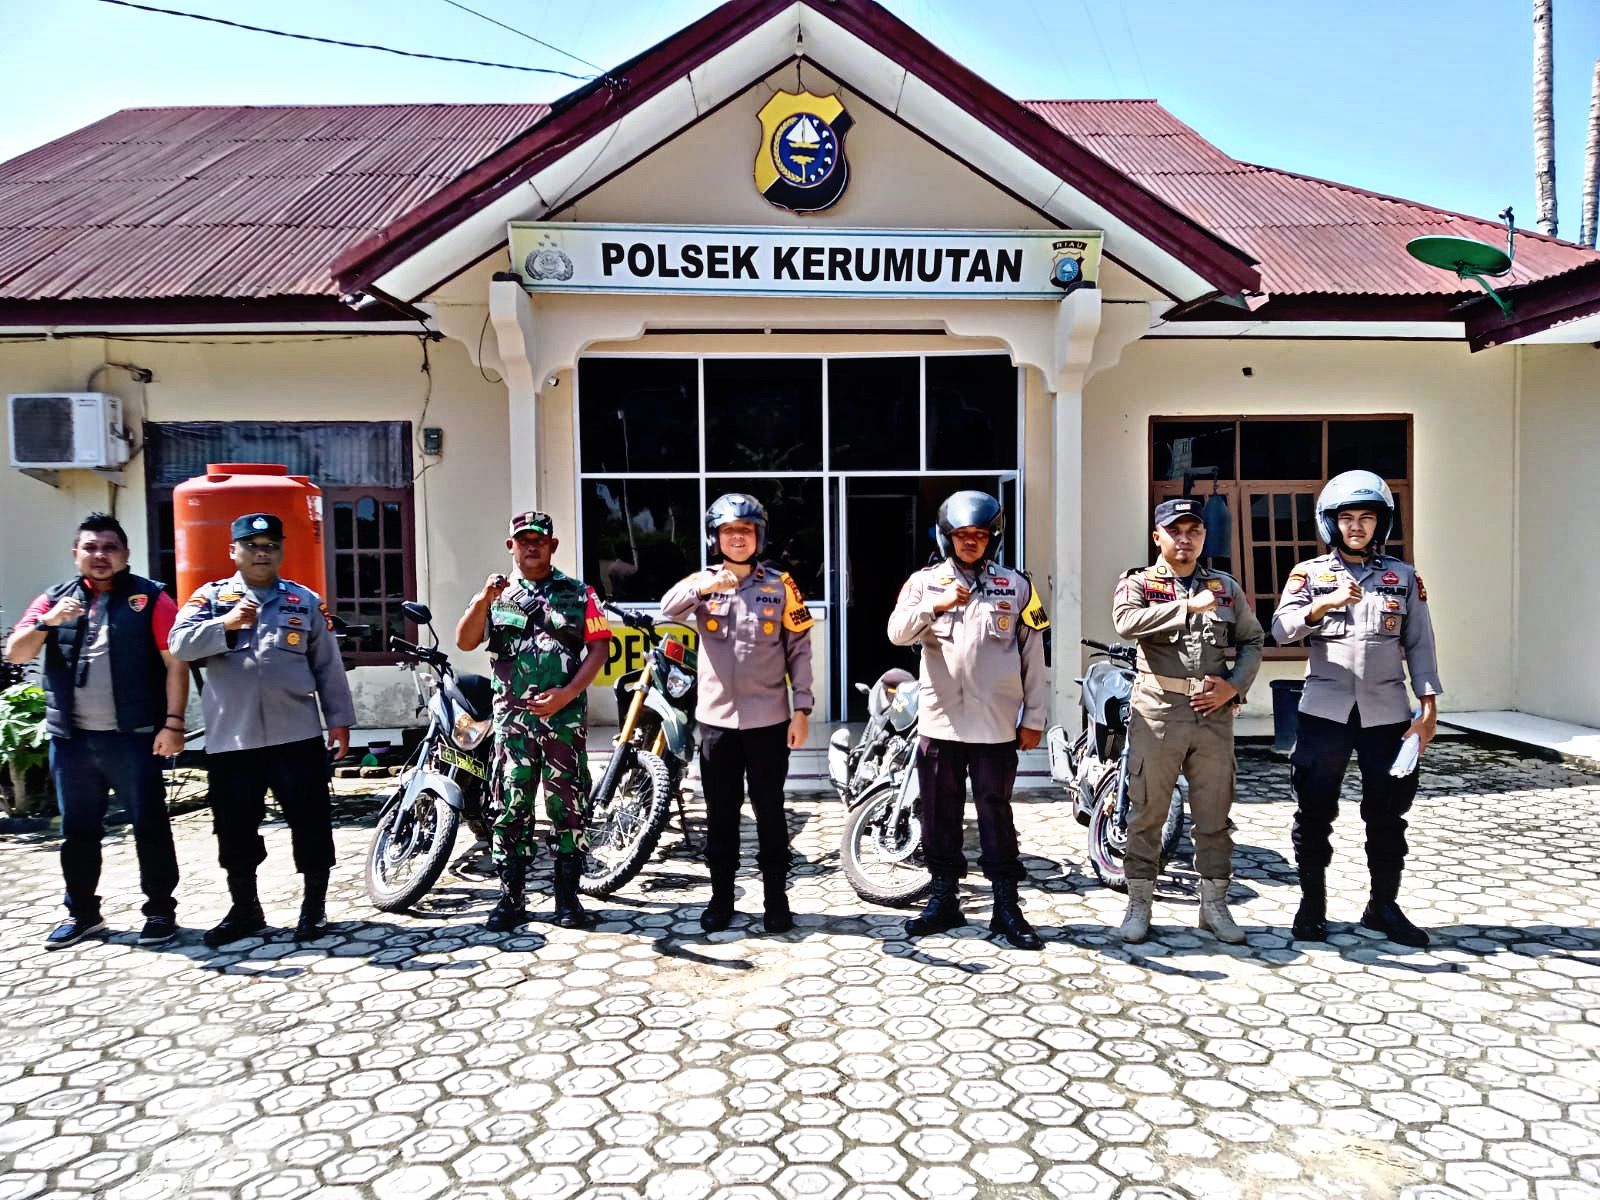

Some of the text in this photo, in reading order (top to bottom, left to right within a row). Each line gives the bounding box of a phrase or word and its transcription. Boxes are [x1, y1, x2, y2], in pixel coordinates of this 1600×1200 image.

[1056, 241, 1083, 249] RIAU
[601, 242, 1024, 283] POLSEK KERUMUTAN
[986, 588, 1016, 597] POLRI
[1375, 586, 1407, 597] POLRI
[756, 595, 782, 605] POLRI
[278, 605, 309, 615] POLRI
